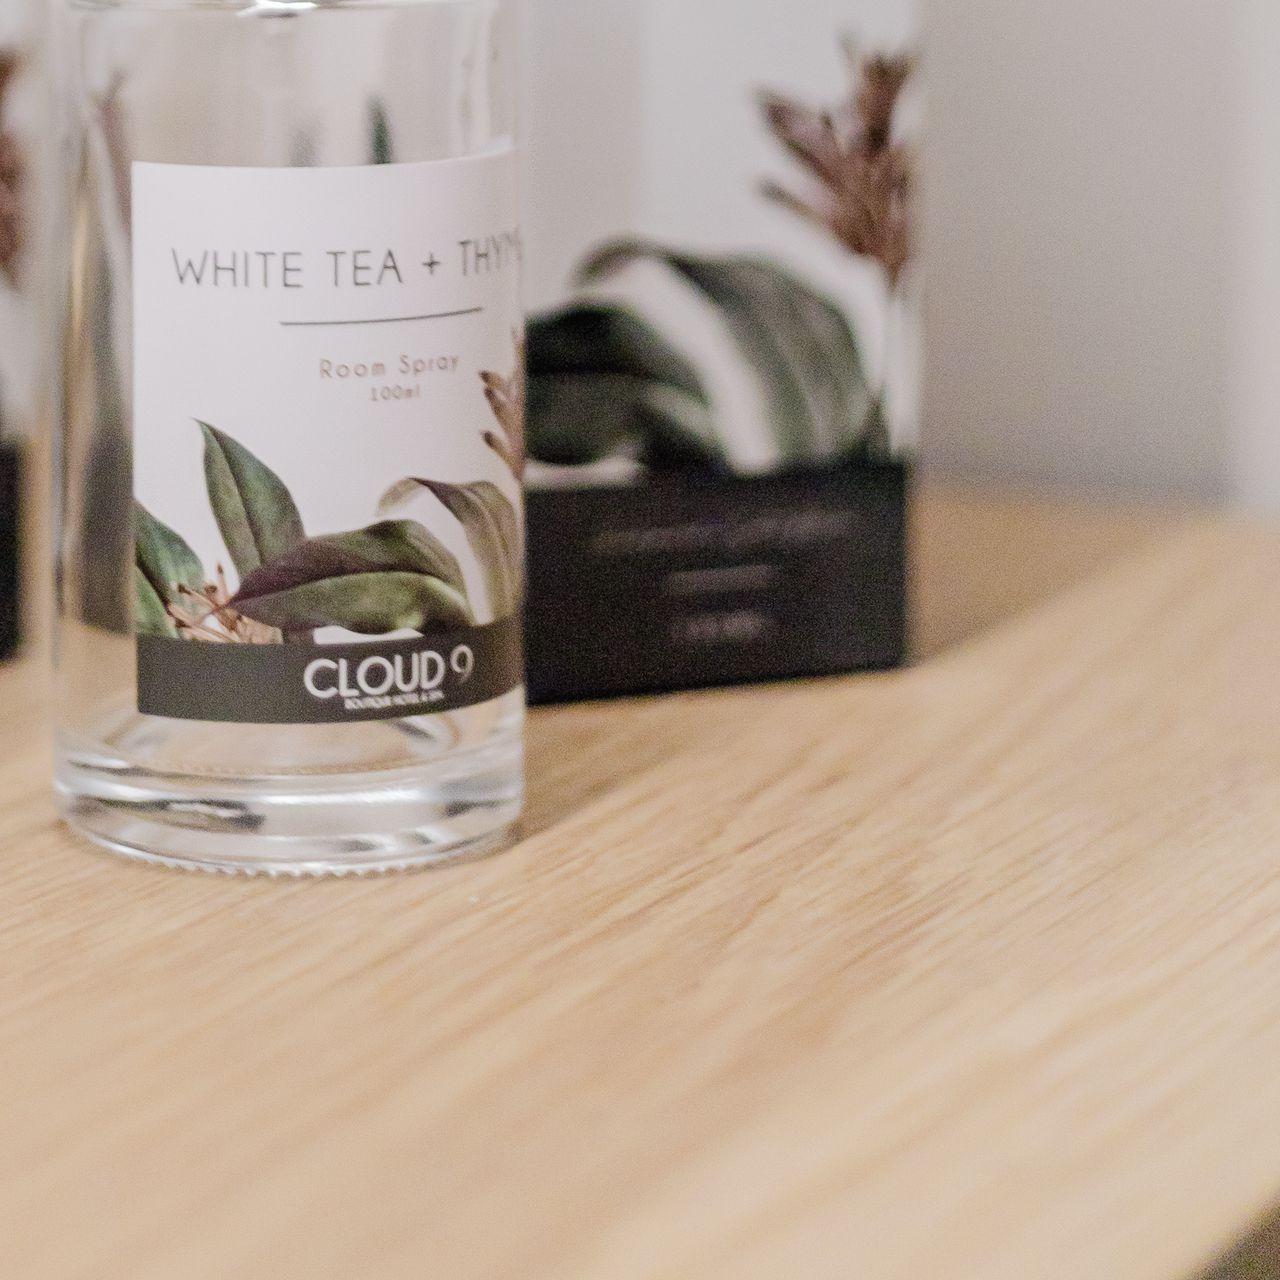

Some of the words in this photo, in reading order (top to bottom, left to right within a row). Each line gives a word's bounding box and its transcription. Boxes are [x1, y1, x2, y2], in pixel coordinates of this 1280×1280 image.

[171, 247, 303, 289] WHITE
[326, 249, 404, 288] TEA
[422, 252, 441, 275] +
[320, 358, 386, 380] Room
[399, 353, 460, 377] Spray
[370, 384, 421, 402] 100ml
[303, 650, 445, 699] CLOUD
[450, 644, 474, 685] 9
